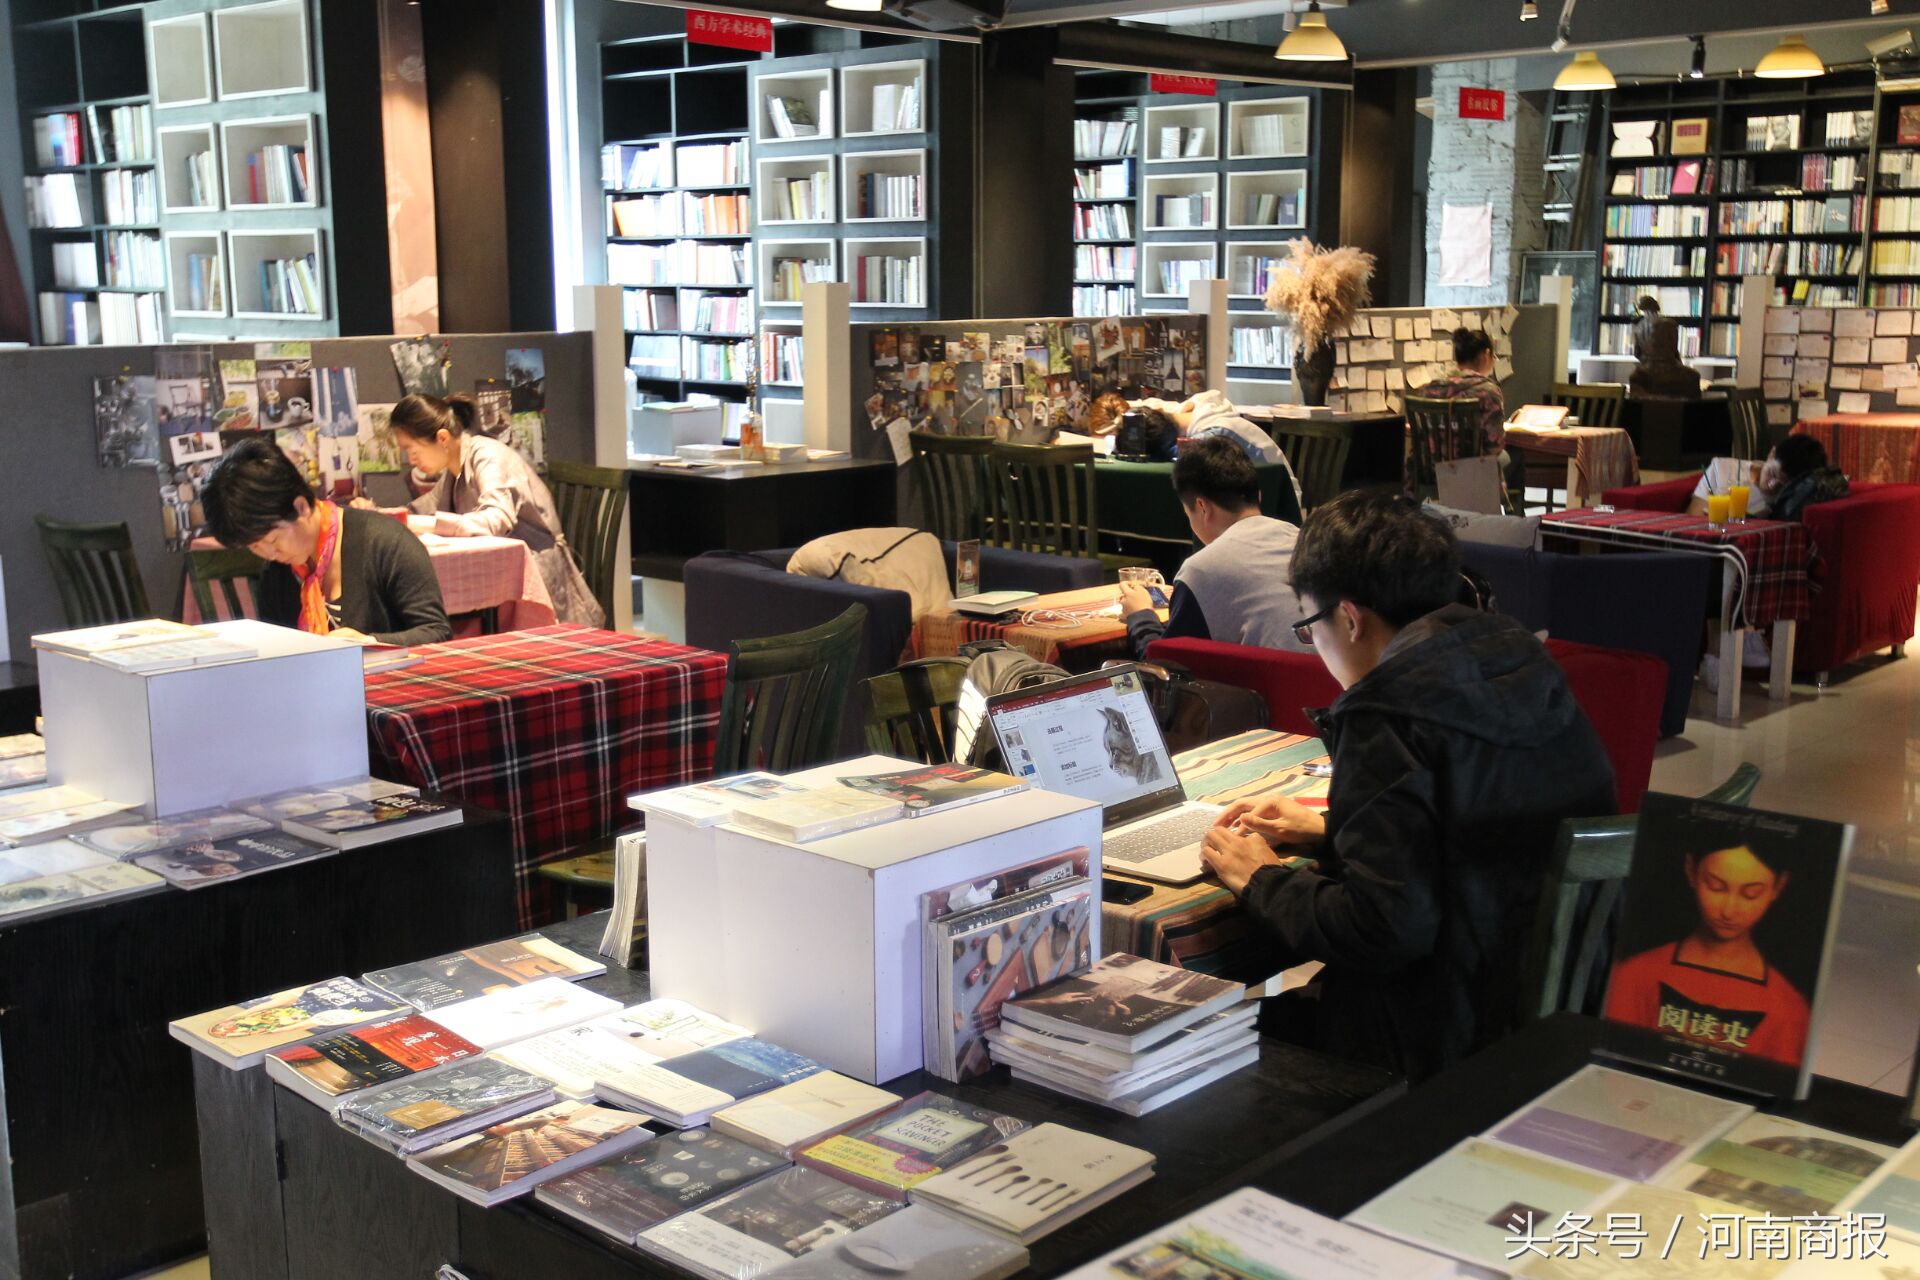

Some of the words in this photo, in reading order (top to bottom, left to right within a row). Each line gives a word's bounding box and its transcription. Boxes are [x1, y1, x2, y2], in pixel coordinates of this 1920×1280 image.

[694, 14, 767, 38] 西方学术经典
[1658, 1003, 1750, 1048] 阅读史
[908, 1120, 953, 1138] POCKET
[919, 1114, 947, 1126] THE
